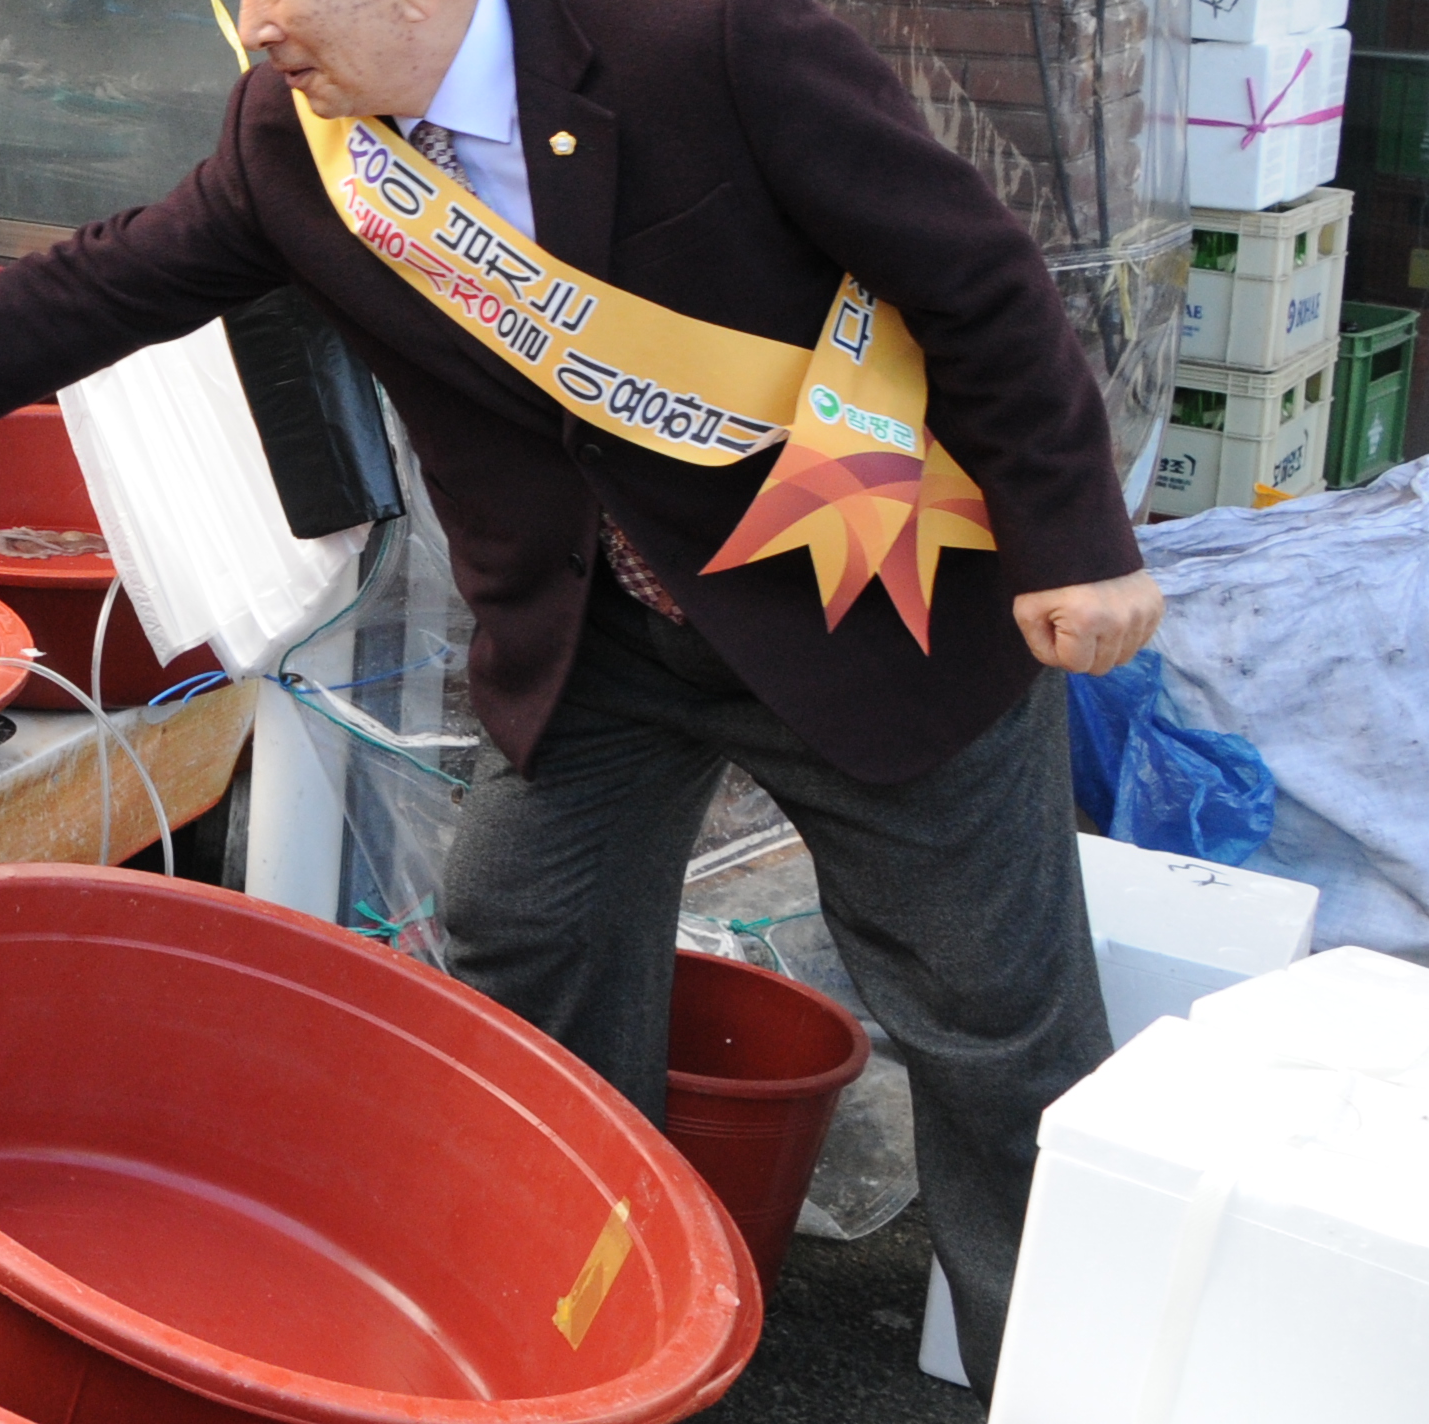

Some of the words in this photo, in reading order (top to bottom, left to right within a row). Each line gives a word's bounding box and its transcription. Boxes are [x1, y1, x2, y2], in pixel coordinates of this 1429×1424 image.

[347, 123, 435, 216] 정이
[434, 205, 593, 332] 넘치는
[845, 405, 914, 449] 함평군
